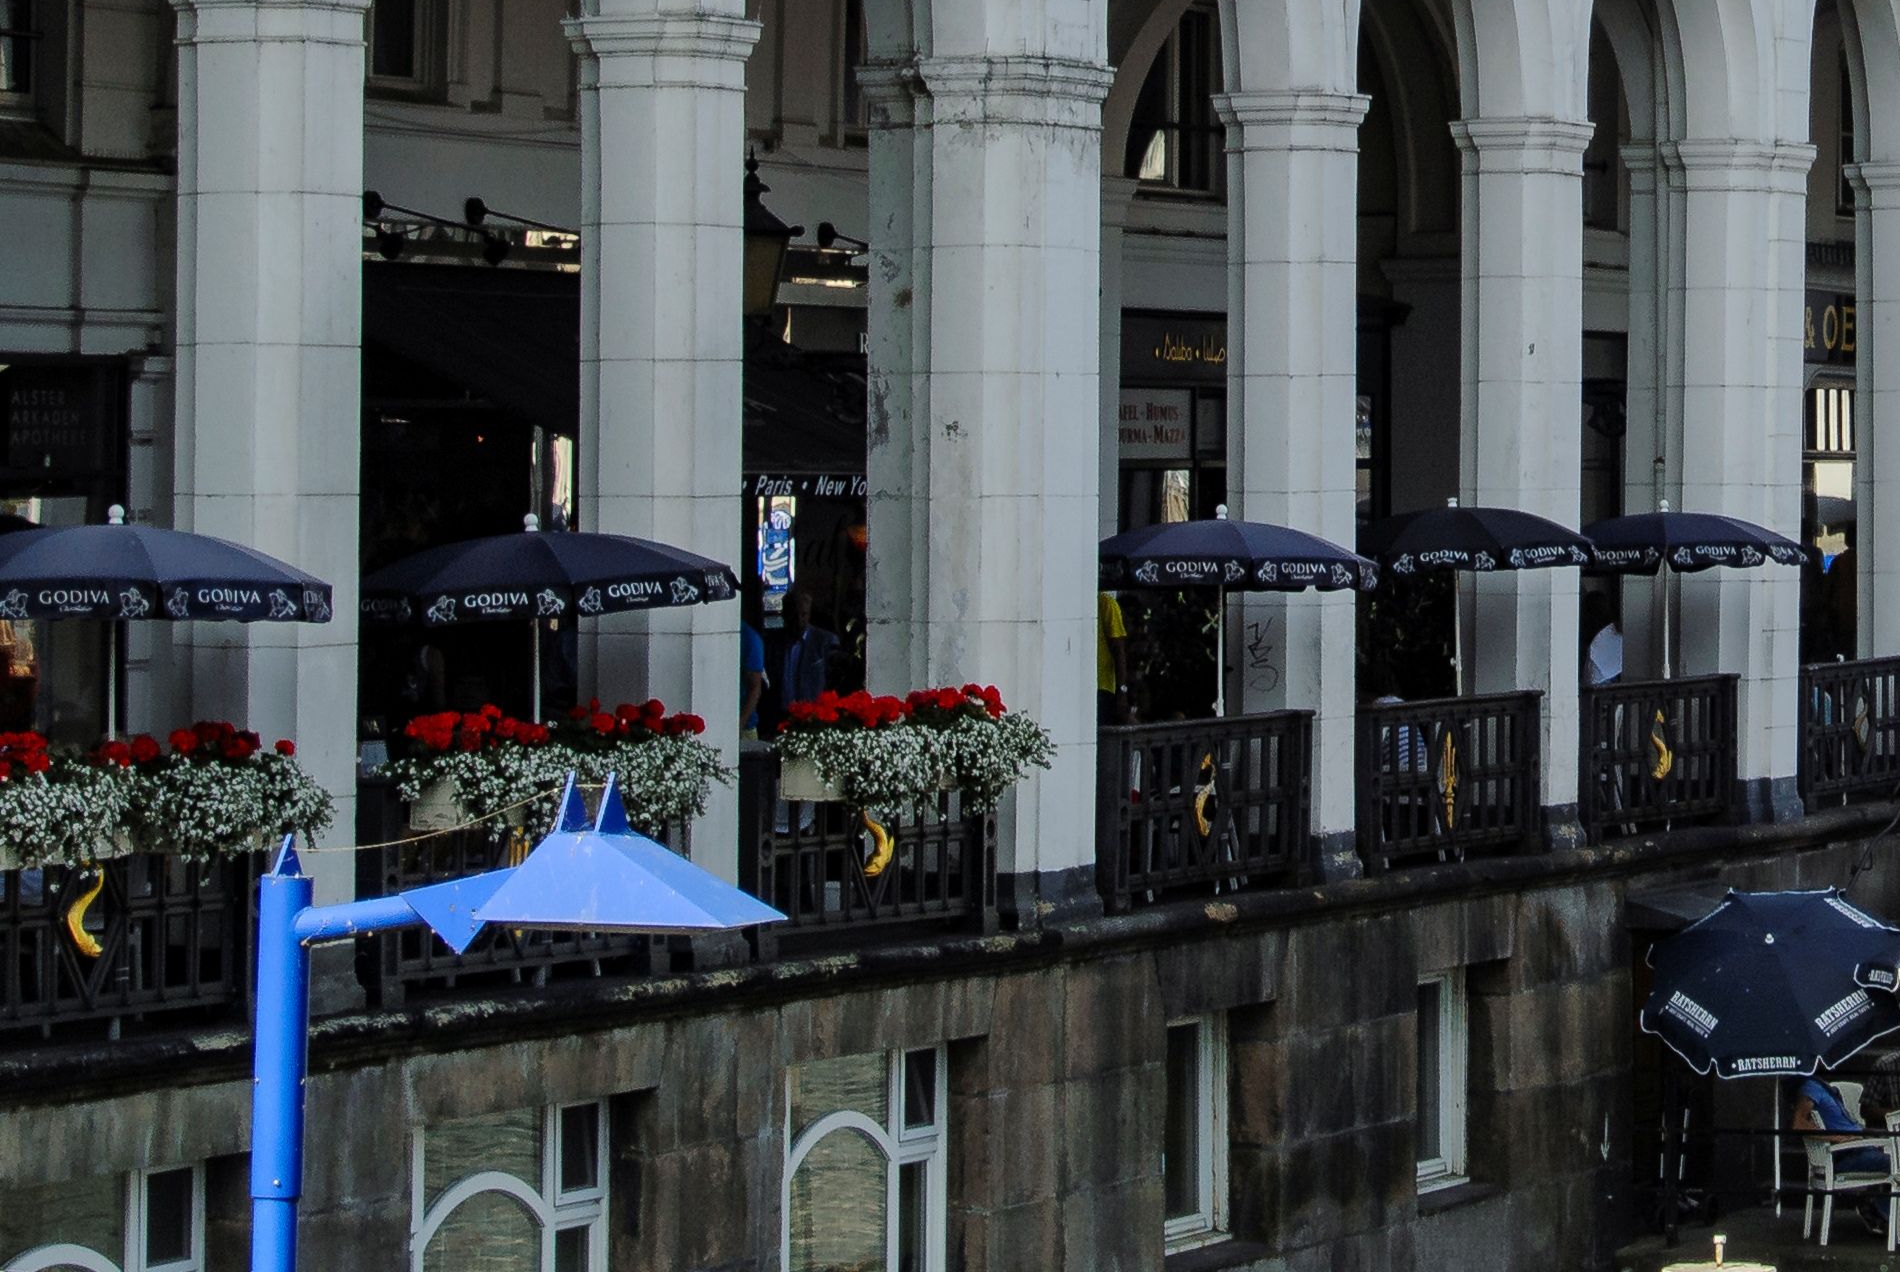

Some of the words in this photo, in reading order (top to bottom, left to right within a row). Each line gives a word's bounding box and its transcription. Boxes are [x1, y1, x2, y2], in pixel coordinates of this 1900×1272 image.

[1805, 306, 1816, 349] &
[755, 475, 793, 496] Paris
[815, 475, 847, 496] New
[851, 475, 868, 496] Yo
[1420, 550, 1469, 562] GODIVA
[1695, 546, 1737, 557] GODIVA
[1165, 561, 1219, 573] GODIVA
[1281, 562, 1327, 575] GODIVA
[39, 590, 110, 605] GODIVA
[198, 588, 262, 604] GODIVA
[608, 581, 663, 598] GODIVA
[464, 592, 529, 609] GODIVA
[1671, 990, 1718, 1029] RATSHERRN
[1814, 987, 1869, 1029] RATSHERRN
[1737, 1055, 1797, 1071] RATSHERRN
